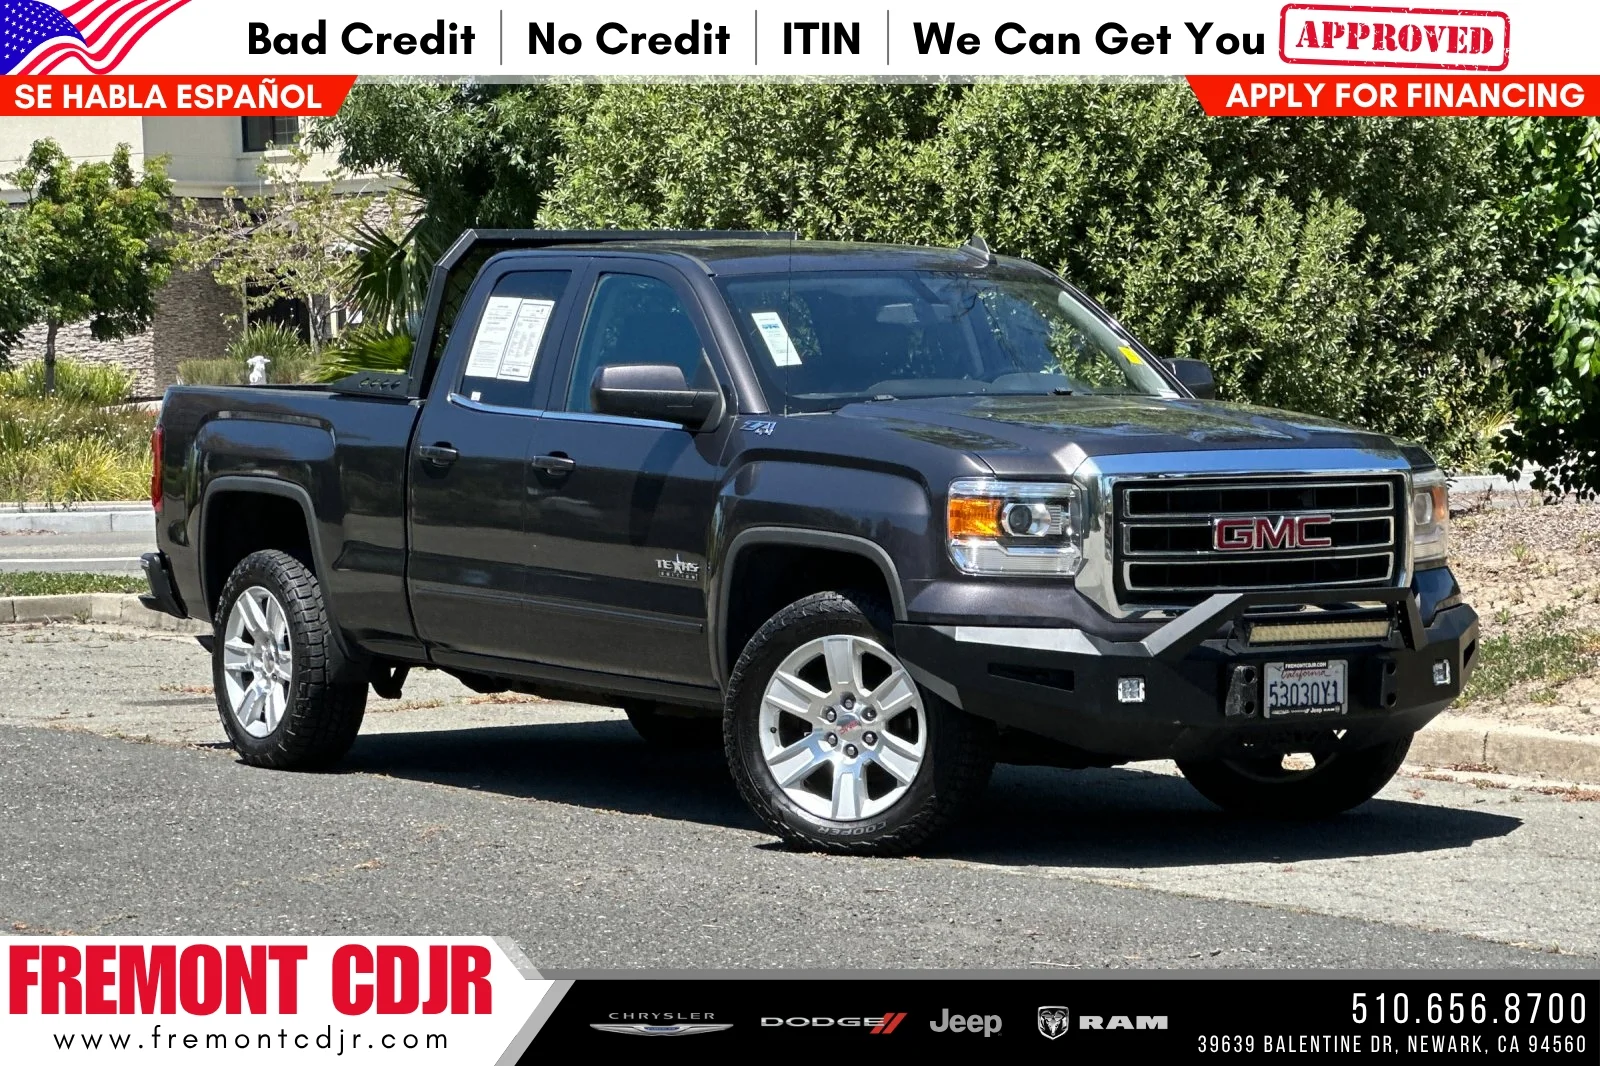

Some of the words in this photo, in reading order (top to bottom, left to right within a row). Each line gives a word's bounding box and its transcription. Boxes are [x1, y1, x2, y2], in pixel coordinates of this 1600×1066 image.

[1213, 515, 1332, 550] GMC
[655, 556, 700, 574] TEXAS
[1281, 669, 1331, 681] California
[1269, 680, 1338, 707] 53030Y1
[817, 821, 887, 836] COOPER
